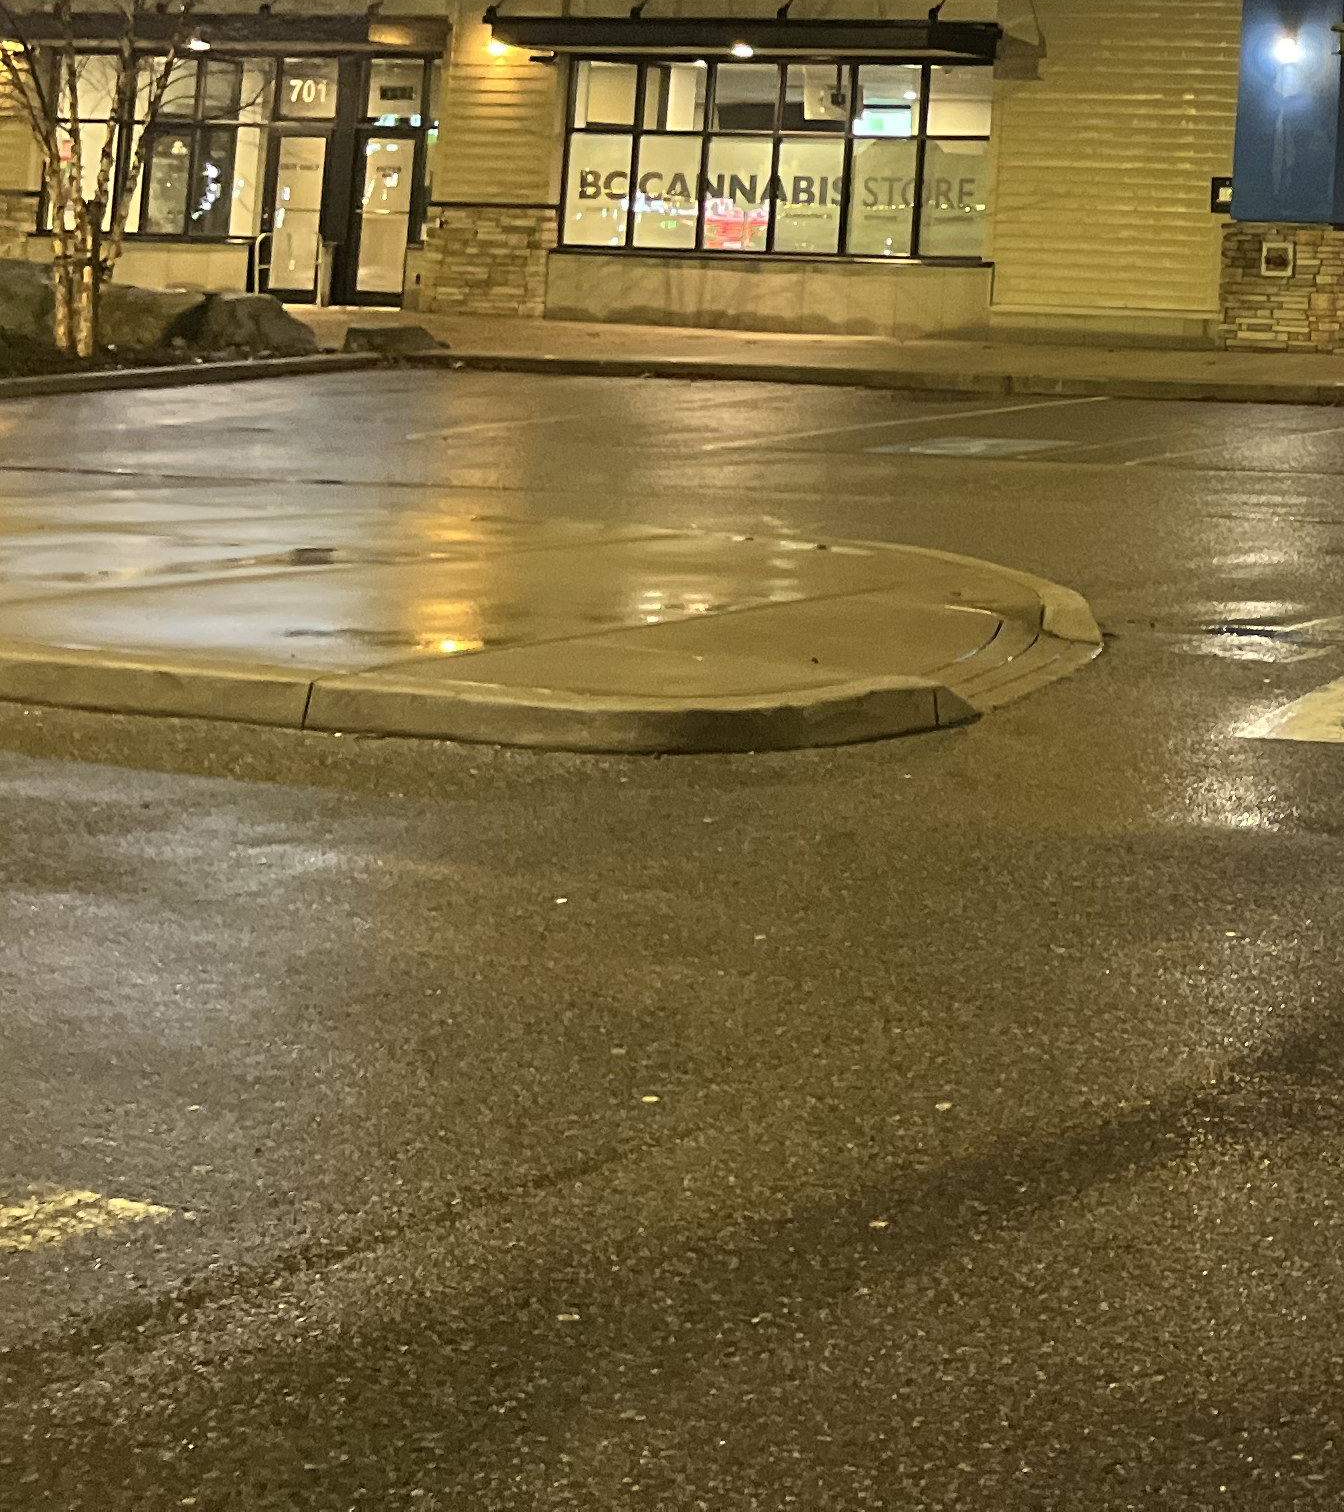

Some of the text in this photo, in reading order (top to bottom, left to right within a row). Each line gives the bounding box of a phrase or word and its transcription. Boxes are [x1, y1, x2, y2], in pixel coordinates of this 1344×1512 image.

[290, 79, 327, 103] 701
[579, 169, 629, 200] BC
[638, 172, 853, 207] CANNABIS
